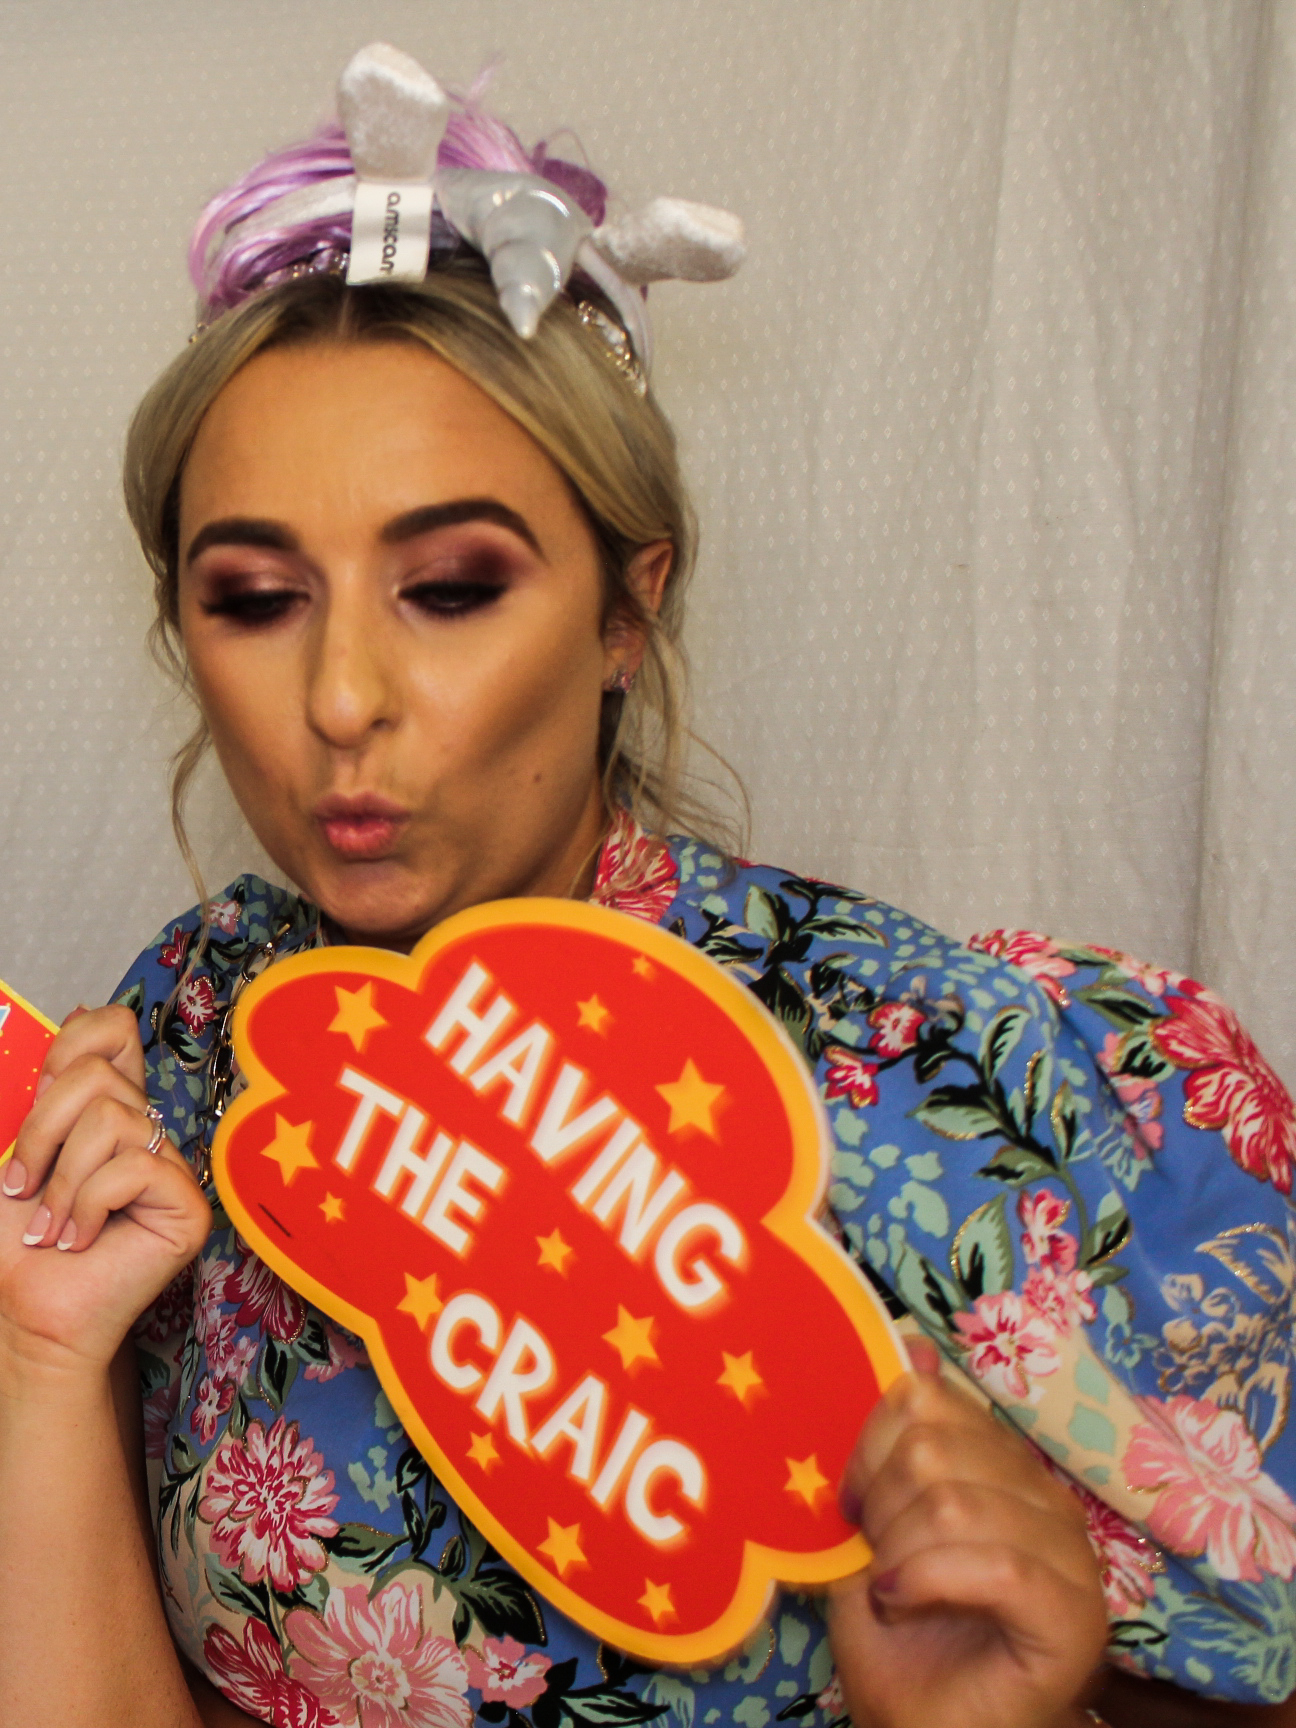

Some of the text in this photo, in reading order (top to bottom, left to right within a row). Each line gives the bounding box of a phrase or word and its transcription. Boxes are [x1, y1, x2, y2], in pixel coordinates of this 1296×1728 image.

[379, 191, 401, 275] amscan
[332, 1066, 505, 1257] THE
[423, 960, 746, 1309] HAVING
[428, 1292, 705, 1543] CRAIC
